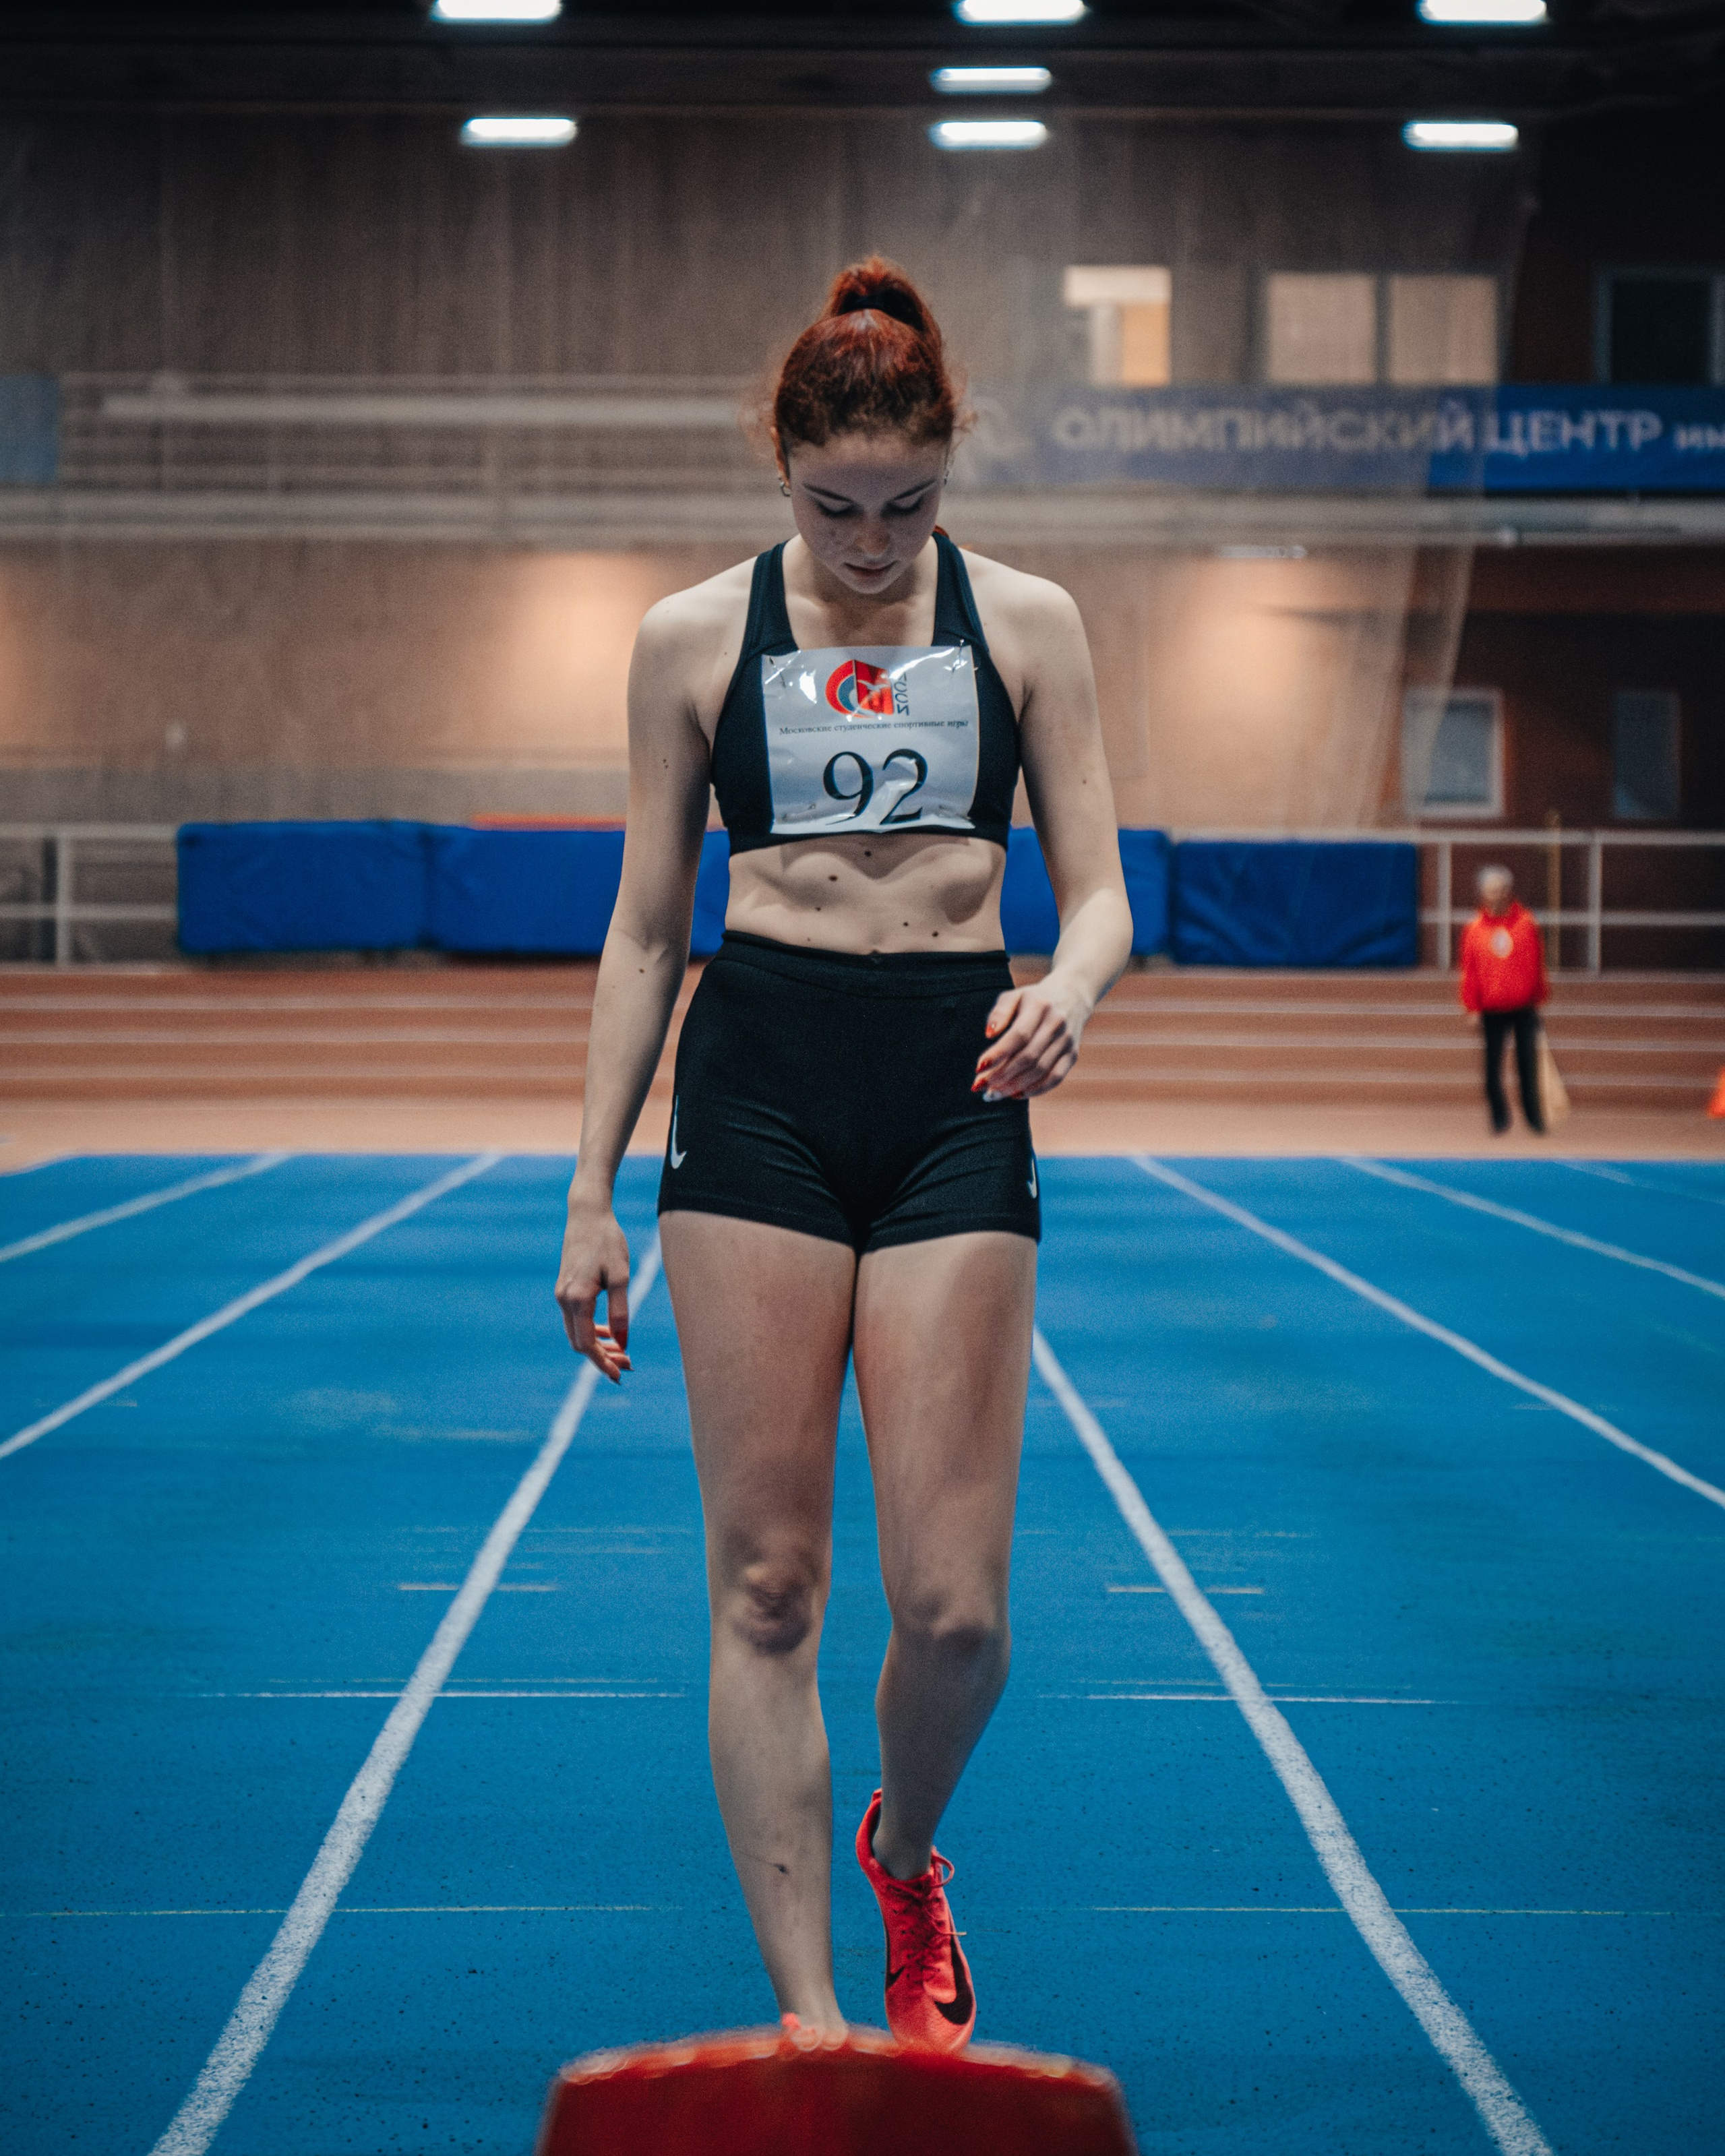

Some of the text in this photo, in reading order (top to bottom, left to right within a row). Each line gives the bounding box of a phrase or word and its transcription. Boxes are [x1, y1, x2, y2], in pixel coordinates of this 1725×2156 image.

[1053, 402, 1475, 450] ОЛИМПИЙСКИЙ
[1484, 409, 1663, 458] ЦЕНТР
[779, 720, 969, 735] Московские студенческие спортивные игры
[823, 748, 928, 826] 92
